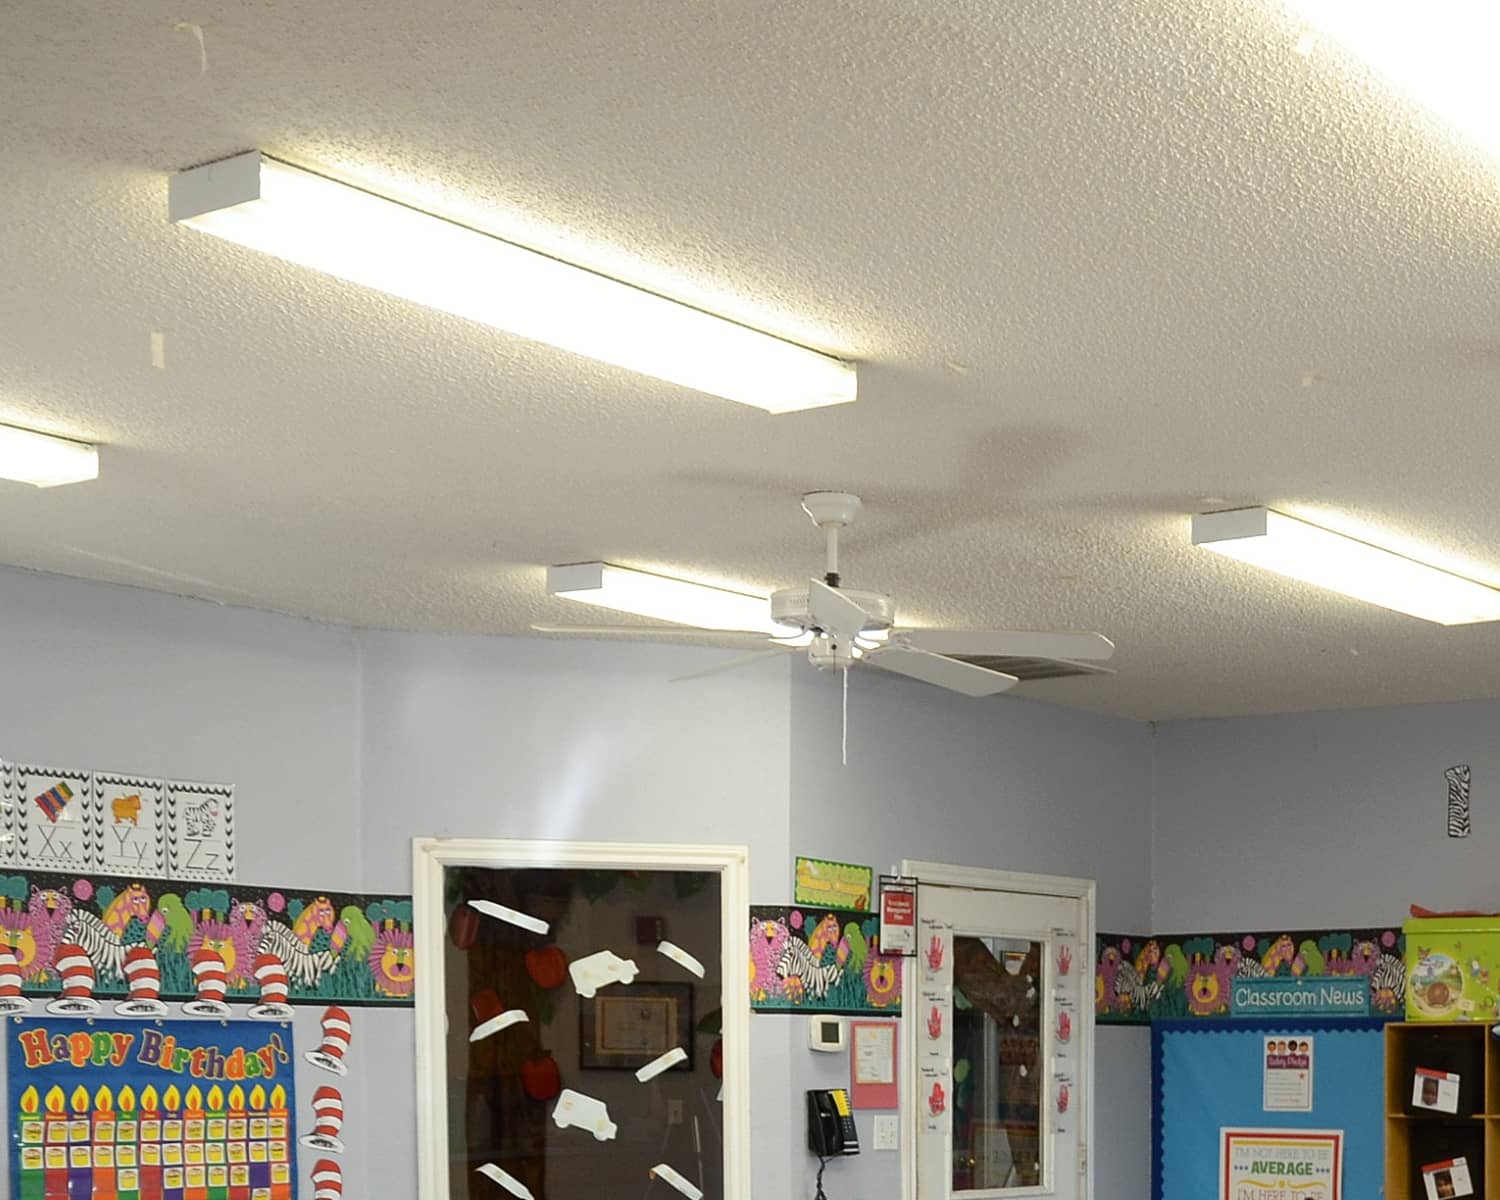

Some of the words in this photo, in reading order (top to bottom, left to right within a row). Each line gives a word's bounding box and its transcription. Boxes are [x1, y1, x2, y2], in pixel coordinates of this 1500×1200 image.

[1235, 987, 1317, 1008] Classroom
[1321, 986, 1365, 1006] News
[18, 1028, 134, 1068] Happy
[138, 1033, 290, 1081] Birthday!
[1251, 1161, 1313, 1175] AVERAGE
[1237, 1189, 1255, 1200] I'M
